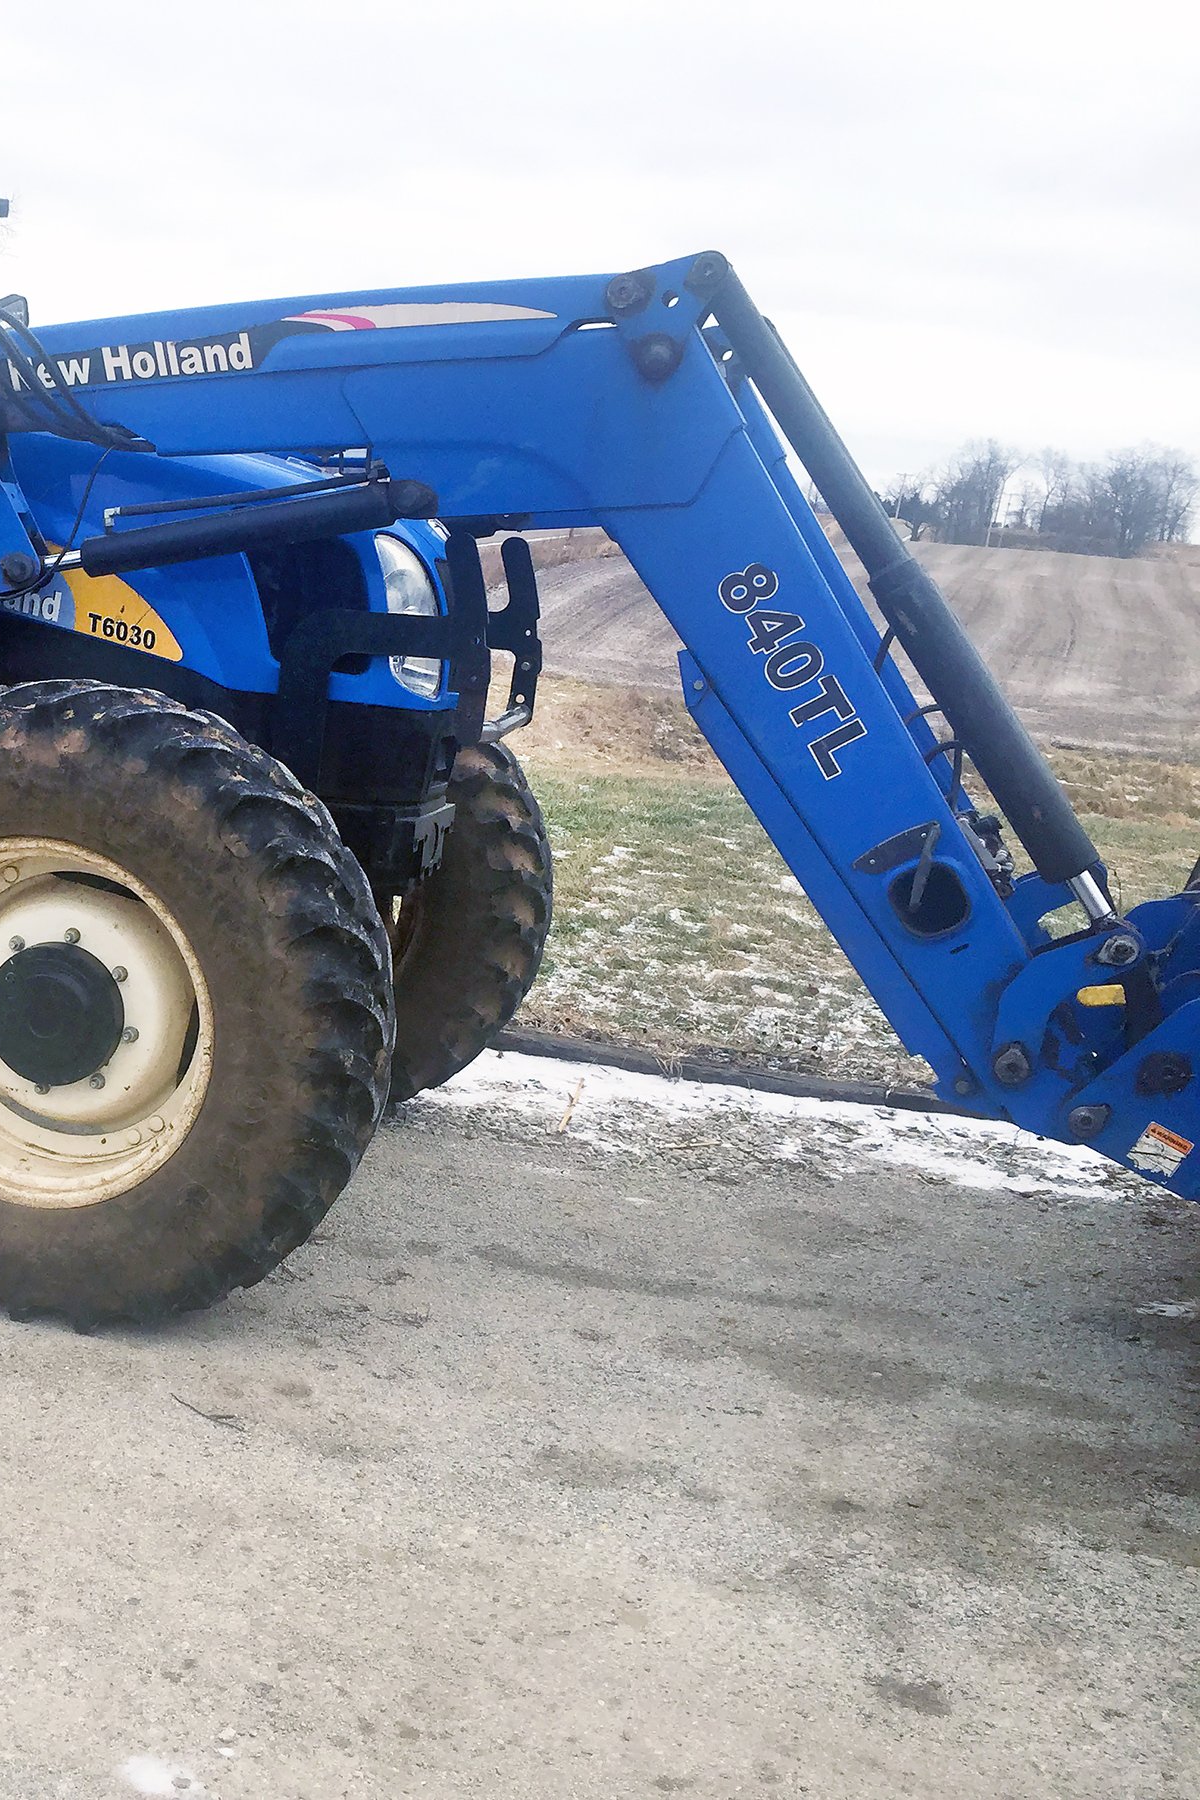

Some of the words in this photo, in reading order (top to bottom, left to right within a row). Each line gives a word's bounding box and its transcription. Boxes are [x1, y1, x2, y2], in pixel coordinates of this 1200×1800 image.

[101, 333, 253, 382] Holland
[88, 613, 156, 650] T6030
[718, 562, 867, 780] 840TL
